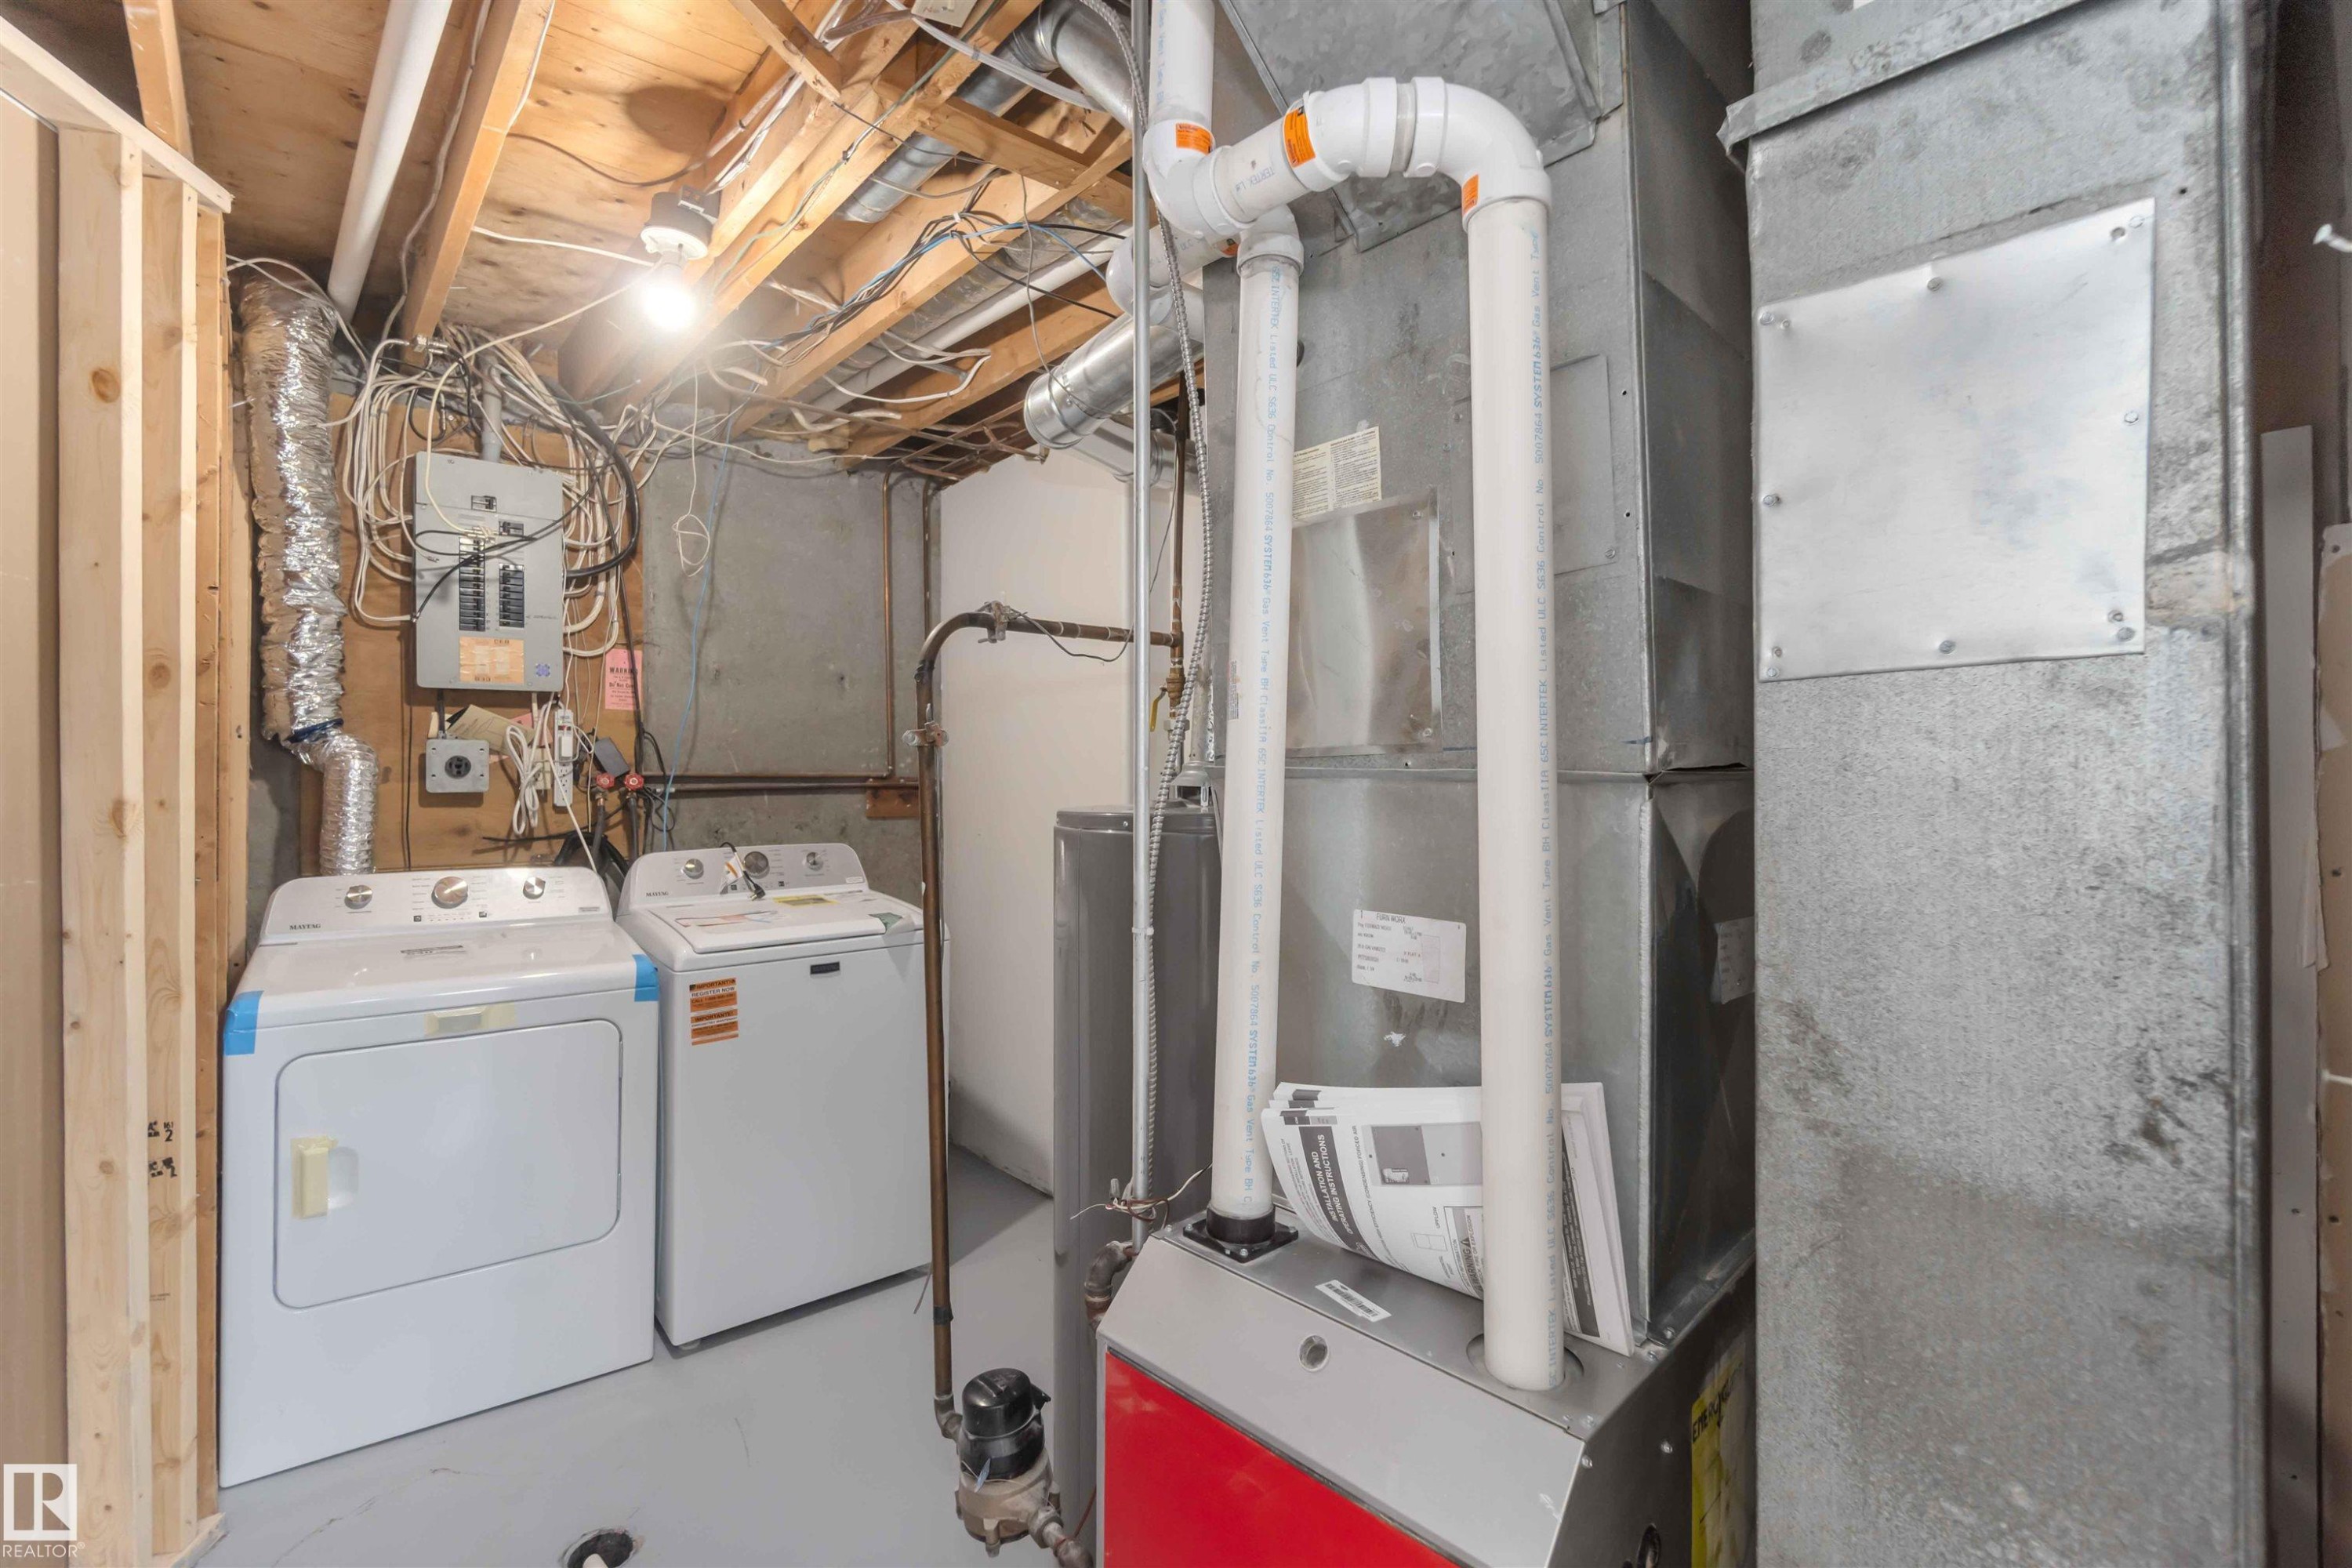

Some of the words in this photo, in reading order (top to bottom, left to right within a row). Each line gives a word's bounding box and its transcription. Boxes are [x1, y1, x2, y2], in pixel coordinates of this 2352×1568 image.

[1530, 270, 1539, 297] Vent
[1270, 285, 1280, 328] INTERTEK
[1532, 306, 1541, 327] Gas
[1269, 334, 1279, 369] Listed
[1269, 373, 1277, 391] ULC
[1268, 396, 1277, 419] S636
[1266, 423, 1276, 463] Control
[1534, 412, 1544, 463] 5007864
[1264, 492, 1274, 532] 5007864
[1536, 502, 1544, 553] Control
[1537, 560, 1546, 590] S636
[1262, 597, 1271, 615] Gas
[1261, 620, 1270, 643] Vent
[1260, 649, 1269, 673] Type
[1260, 678, 1269, 691] BH
[1540, 680, 1548, 738] INTERTEK
[1255, 768, 1265, 813] INTERTEK
[1254, 819, 1264, 855] Listed
[1542, 837, 1550, 852] BH
[1254, 860, 1262, 878] ULC
[1543, 859, 1552, 889] Type
[1253, 884, 1262, 908] S636
[1251, 913, 1261, 954] Control
[691, 989, 720, 997] REGISTER
[1250, 985, 1259, 1026] 5007864
[1545, 1043, 1554, 1094] 5007864
[1247, 1094, 1255, 1112] Gas
[1246, 1119, 1254, 1142] Vent
[1244, 1149, 1254, 1173] Type
[1311, 1151, 1322, 1170] AND
[1354, 1136, 1363, 1160] FORCED
[1546, 1133, 1555, 1183] Control
[1317, 1134, 1338, 1196] INSTRUCTIONS
[1244, 1178, 1253, 1191] BH
[1316, 1170, 1338, 1221] INSTALLATION
[1333, 1197, 1353, 1235] OPERATING
[1548, 1254, 1556, 1301] Listed
